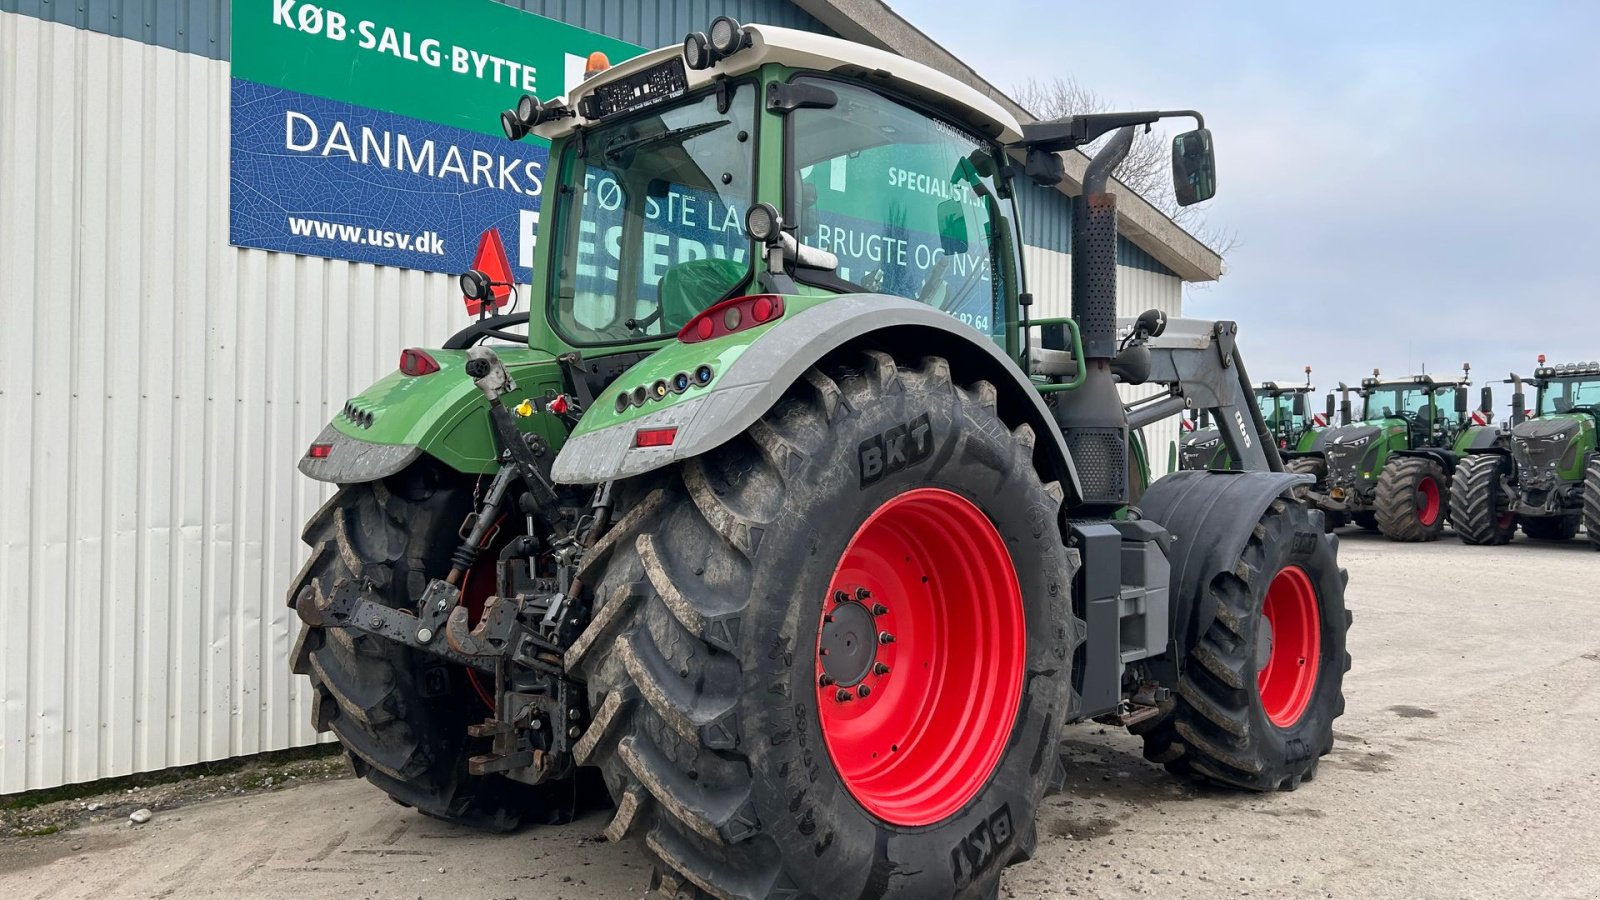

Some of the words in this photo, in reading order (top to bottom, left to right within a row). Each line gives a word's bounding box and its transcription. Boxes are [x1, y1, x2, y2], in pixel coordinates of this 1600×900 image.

[285, 110, 543, 196] DANMARKS
[818, 223, 907, 267] BRUGTE
[288, 217, 444, 256] www.usv.dk
[975, 314, 988, 331] 64
[860, 418, 932, 485] BKT
